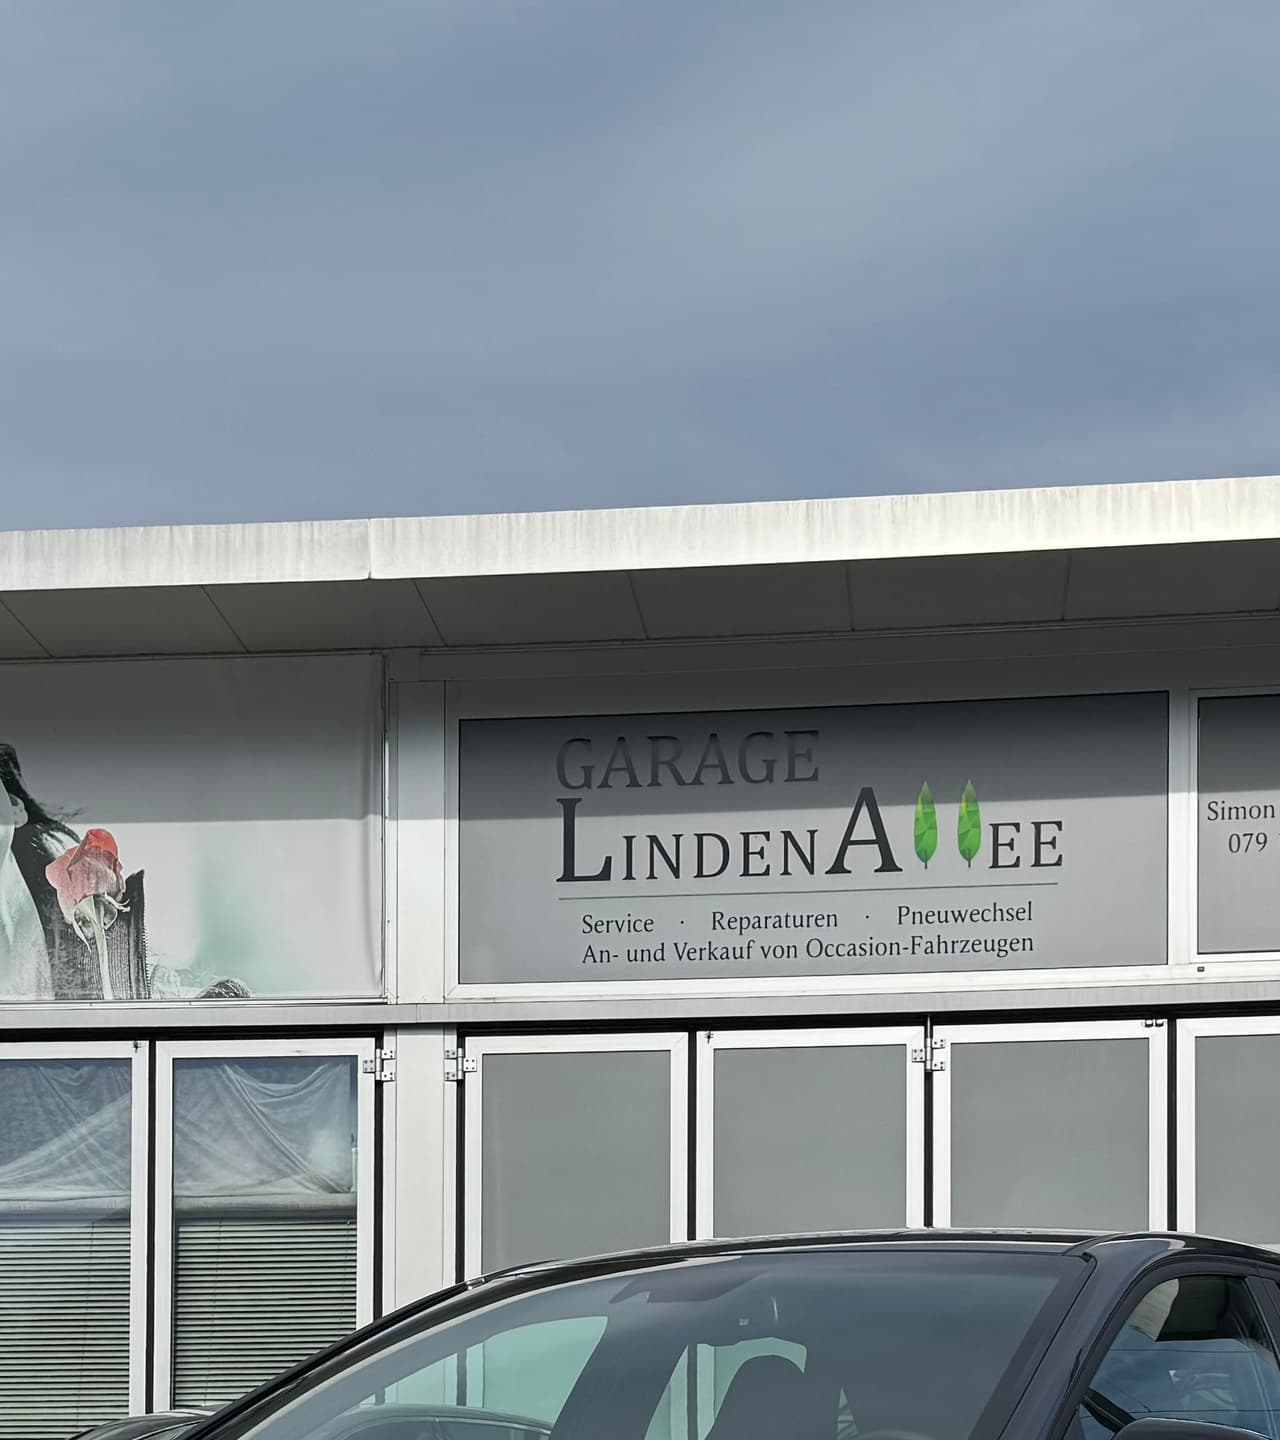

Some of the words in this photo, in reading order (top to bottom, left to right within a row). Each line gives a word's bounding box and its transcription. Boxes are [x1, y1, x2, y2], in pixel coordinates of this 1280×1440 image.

[555, 728, 820, 792] GARAGE
[1206, 799, 1277, 822] Simon
[1227, 831, 1269, 854] 079
[581, 912, 655, 936] Service
[710, 908, 839, 934] Reparaturen
[896, 901, 1034, 927] Pneuwechsel
[581, 942, 620, 965] An-
[626, 941, 667, 963] und
[672, 938, 753, 963] Verkauf
[759, 944, 799, 961] von
[805, 933, 1035, 961] Occasion-Fahrzeugen
